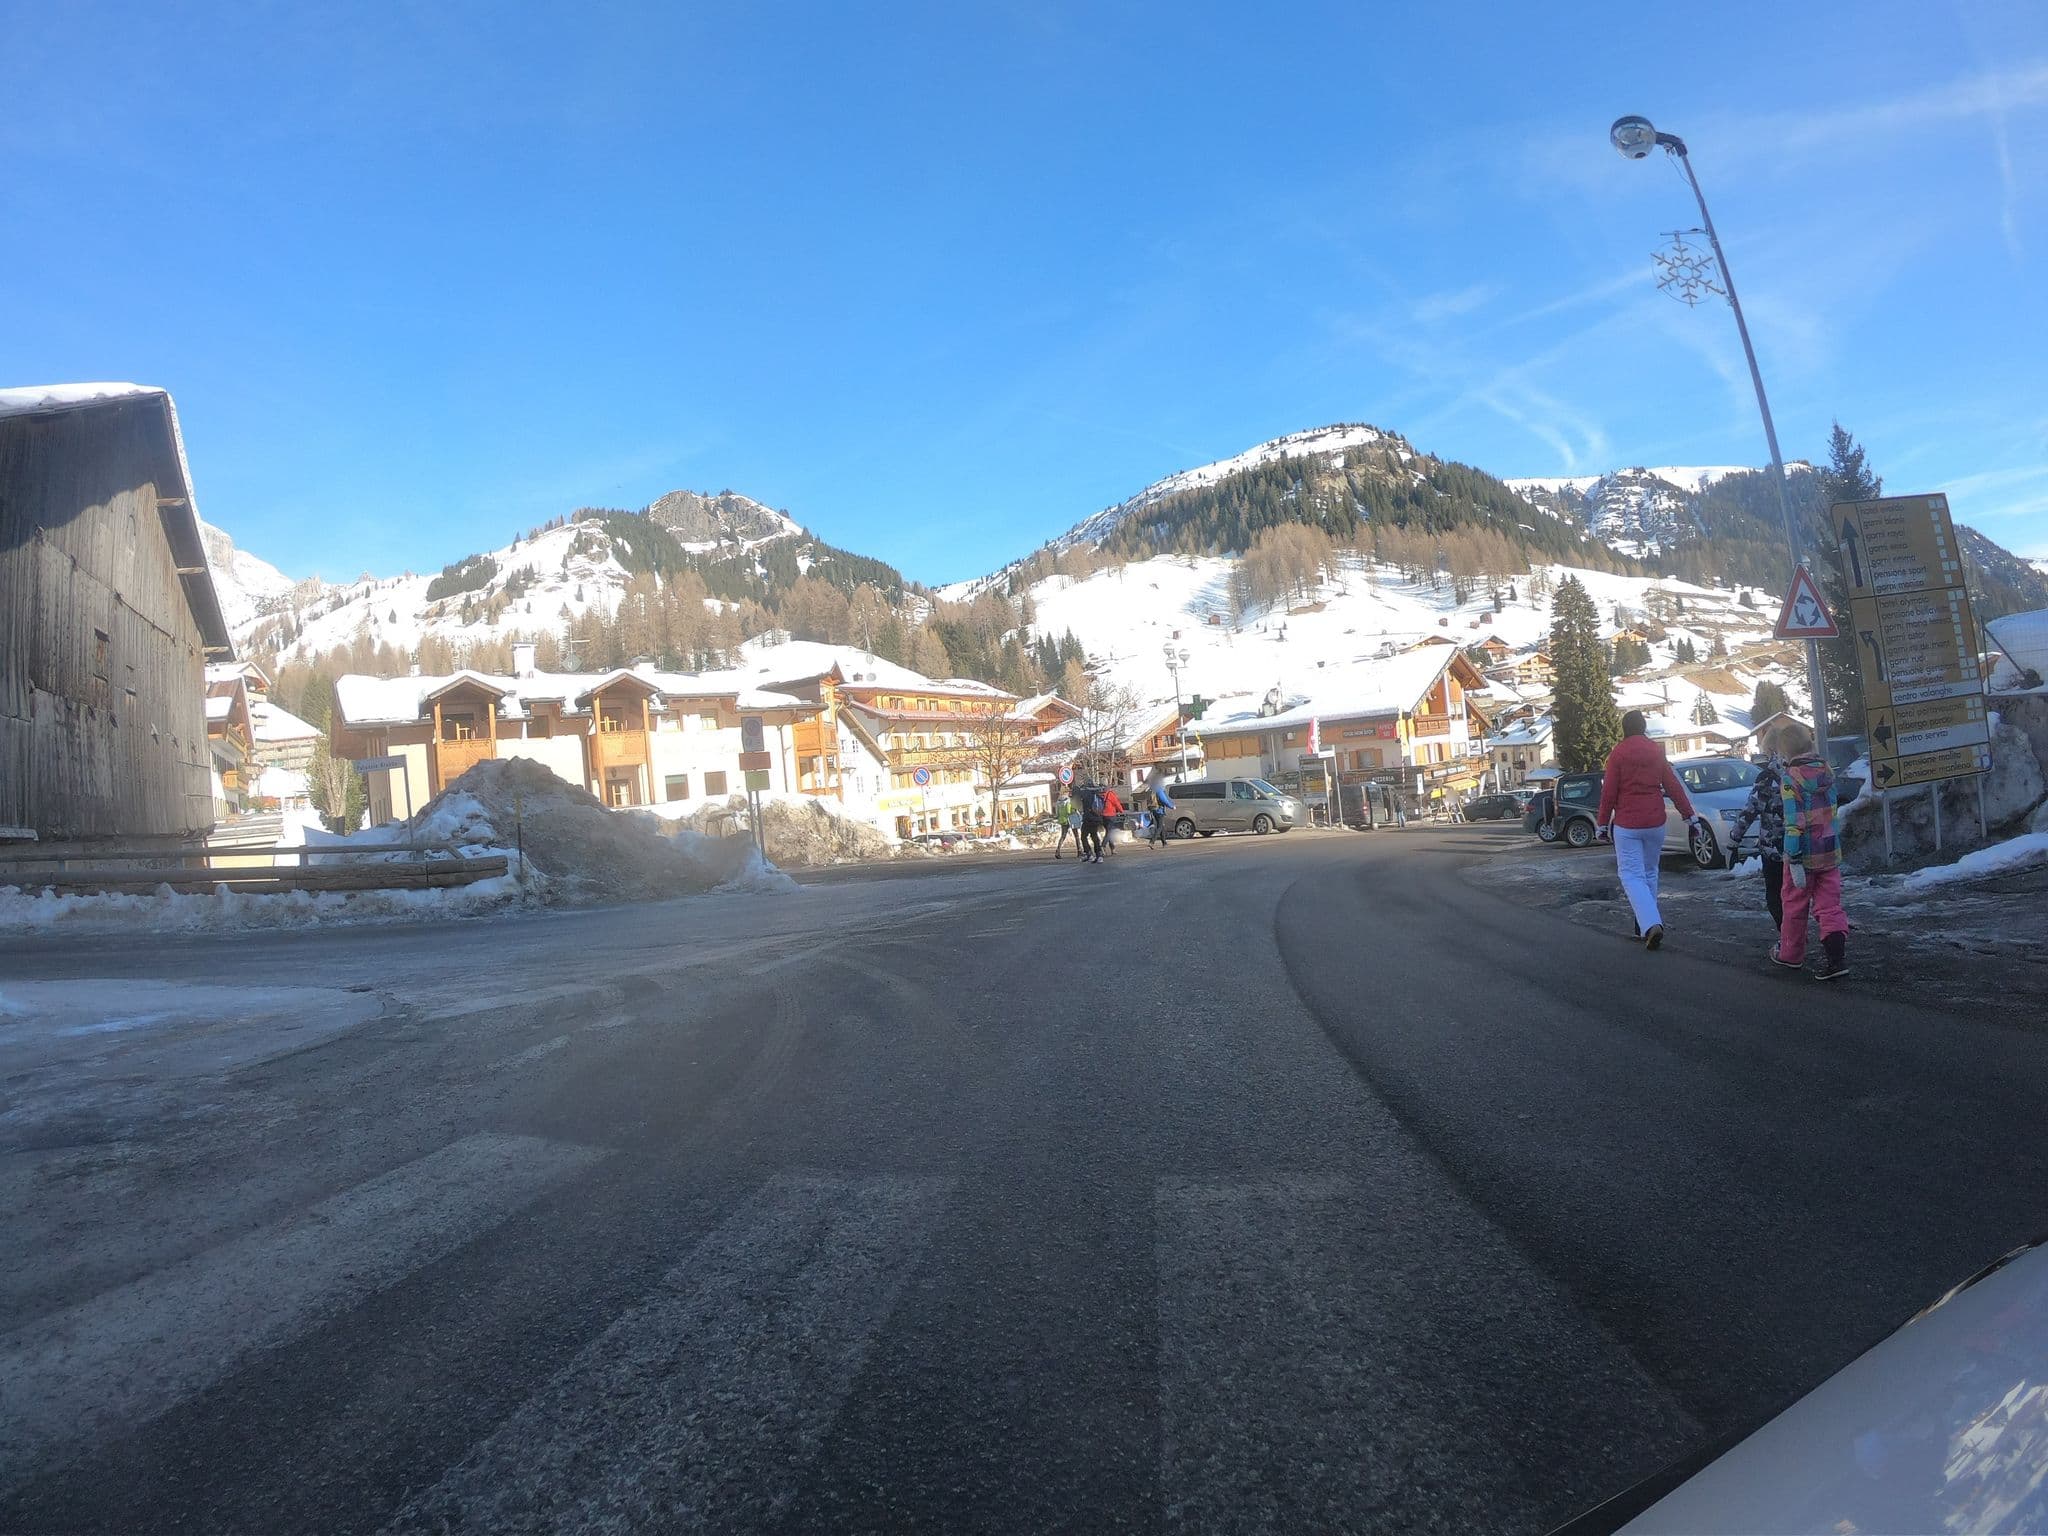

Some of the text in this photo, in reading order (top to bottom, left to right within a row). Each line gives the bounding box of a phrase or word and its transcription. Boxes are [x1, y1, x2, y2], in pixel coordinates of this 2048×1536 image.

[1876, 581, 1896, 593] garni
[1894, 685, 1953, 702] centro valanghe
[1900, 733, 1923, 744] centro
